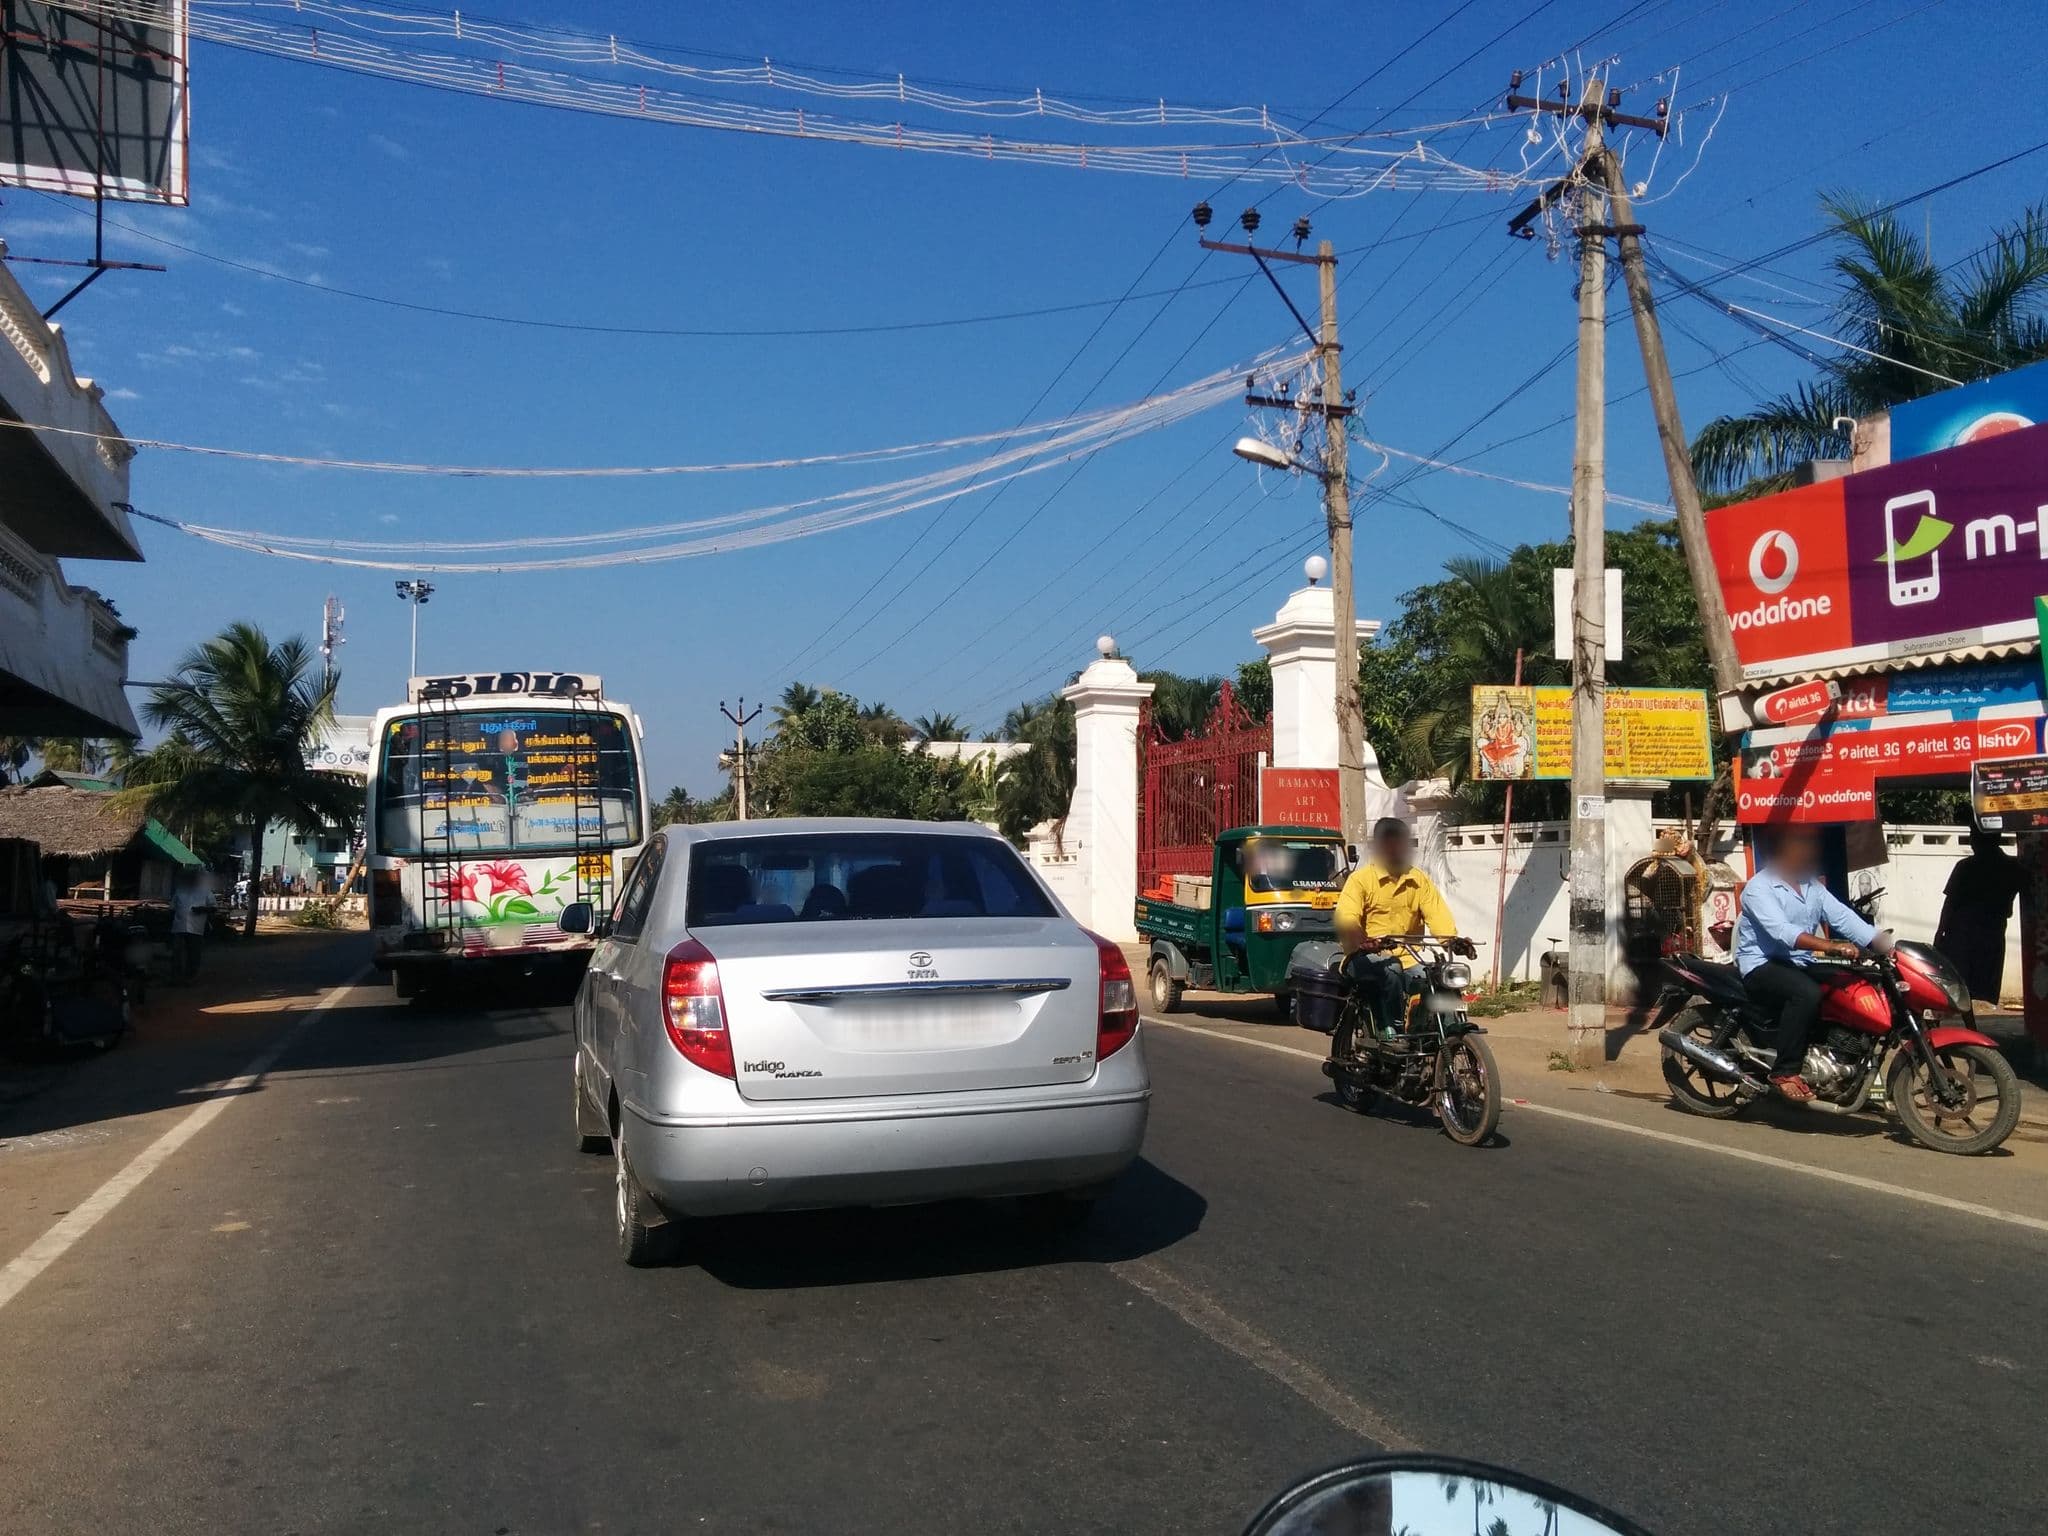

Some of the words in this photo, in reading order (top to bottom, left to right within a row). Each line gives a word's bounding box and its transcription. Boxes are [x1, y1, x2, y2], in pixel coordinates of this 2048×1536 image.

[1727, 595, 1831, 632] vodafone
[1788, 695, 1810, 709] airtel
[1810, 691, 1822, 704] 3G
[1784, 744, 1825, 758] Vodafone
[1850, 744, 1880, 759] airtel
[1884, 742, 1900, 756] 3G
[1917, 738, 1949, 753] airtel
[1953, 736, 1972, 751] 3G
[1295, 796, 1315, 806] ART
[1754, 794, 1804, 807] vodafone
[1818, 789, 1873, 804] vodafone
[1279, 811, 1330, 823] GALLERY
[907, 969, 940, 979] TATA
[743, 1060, 786, 1074] Indigo
